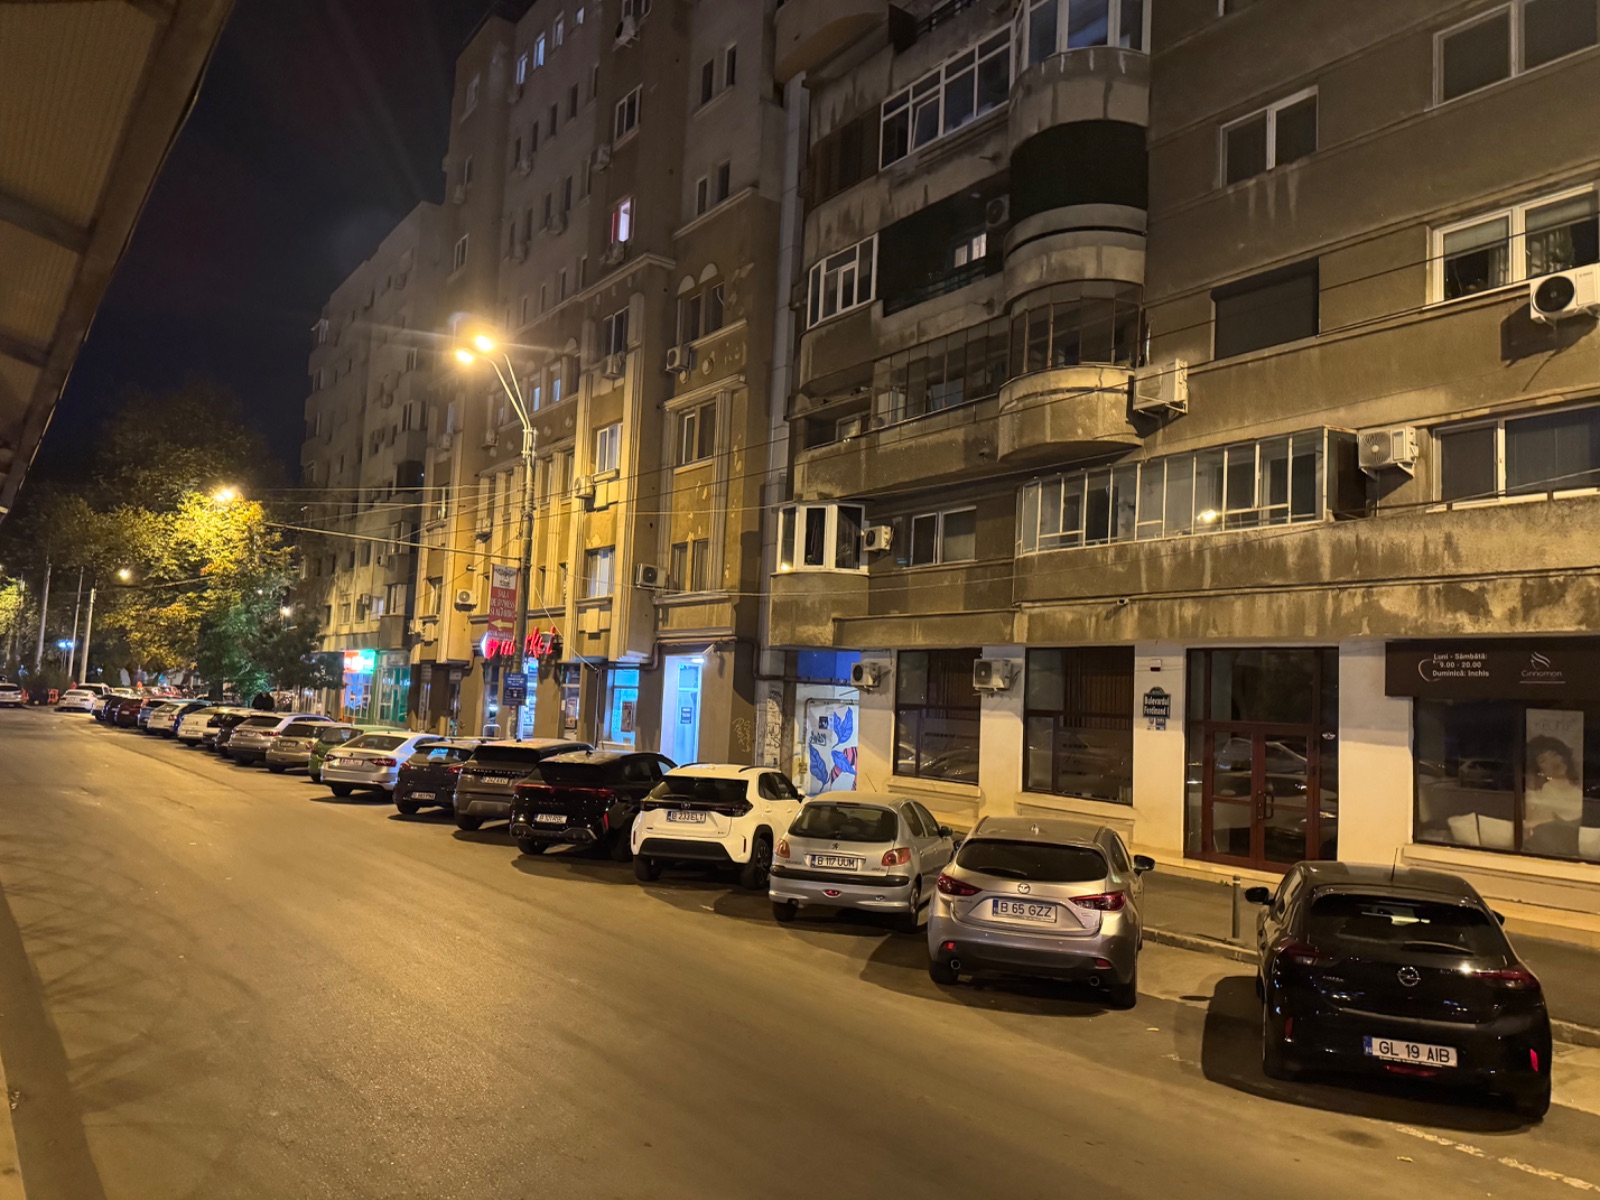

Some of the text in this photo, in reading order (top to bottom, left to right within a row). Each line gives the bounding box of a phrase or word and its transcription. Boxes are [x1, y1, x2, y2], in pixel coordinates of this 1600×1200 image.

[1521, 669, 1563, 678] Cinnamon
[1001, 902, 1052, 918] B 65 GZZ
[1379, 1041, 1399, 1056] GL
[1405, 1043, 1420, 1059] 19
[1426, 1047, 1450, 1063] AIB
